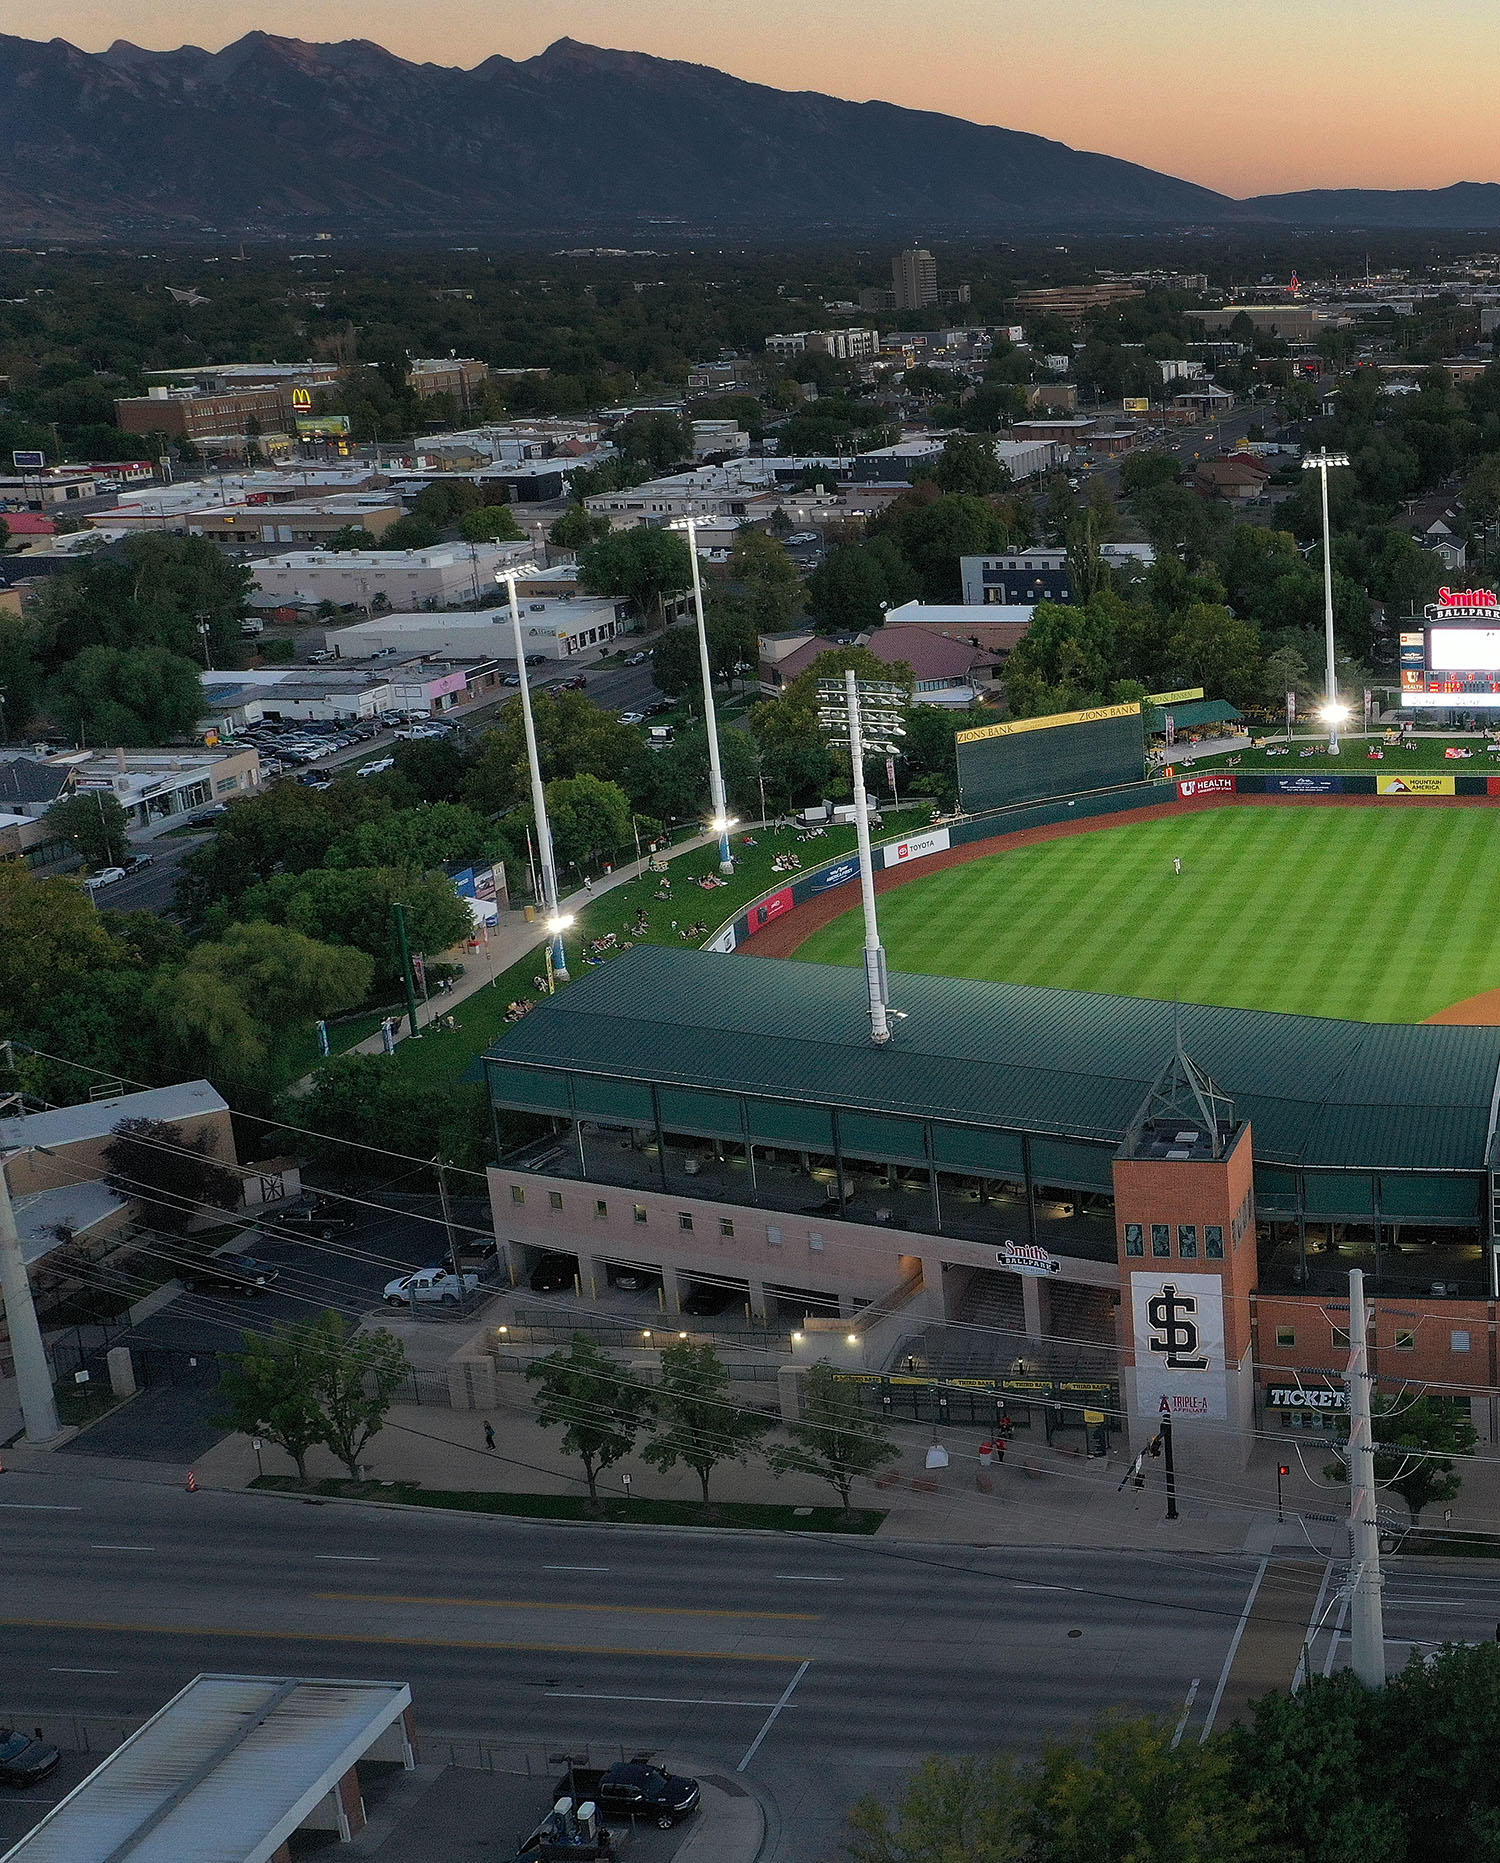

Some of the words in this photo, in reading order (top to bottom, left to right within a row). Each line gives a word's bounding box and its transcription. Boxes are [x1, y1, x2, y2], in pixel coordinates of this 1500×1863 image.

[1438, 586, 1498, 607] Smith's
[1436, 608, 1500, 619] BALLPARK
[1079, 709, 1108, 721] ZIONS
[1110, 704, 1136, 717] BANK
[957, 730, 986, 743] ZIONS
[988, 724, 1014, 737] BANK
[1197, 779, 1232, 790] HEALTH
[910, 840, 935, 852] TOYOTA
[1004, 1239, 1049, 1261] Smith's
[1005, 1257, 1053, 1271] BALLPARK
[1172, 1395, 1208, 1408] TRIPLE-A
[1271, 1389, 1346, 1407] TICKET
